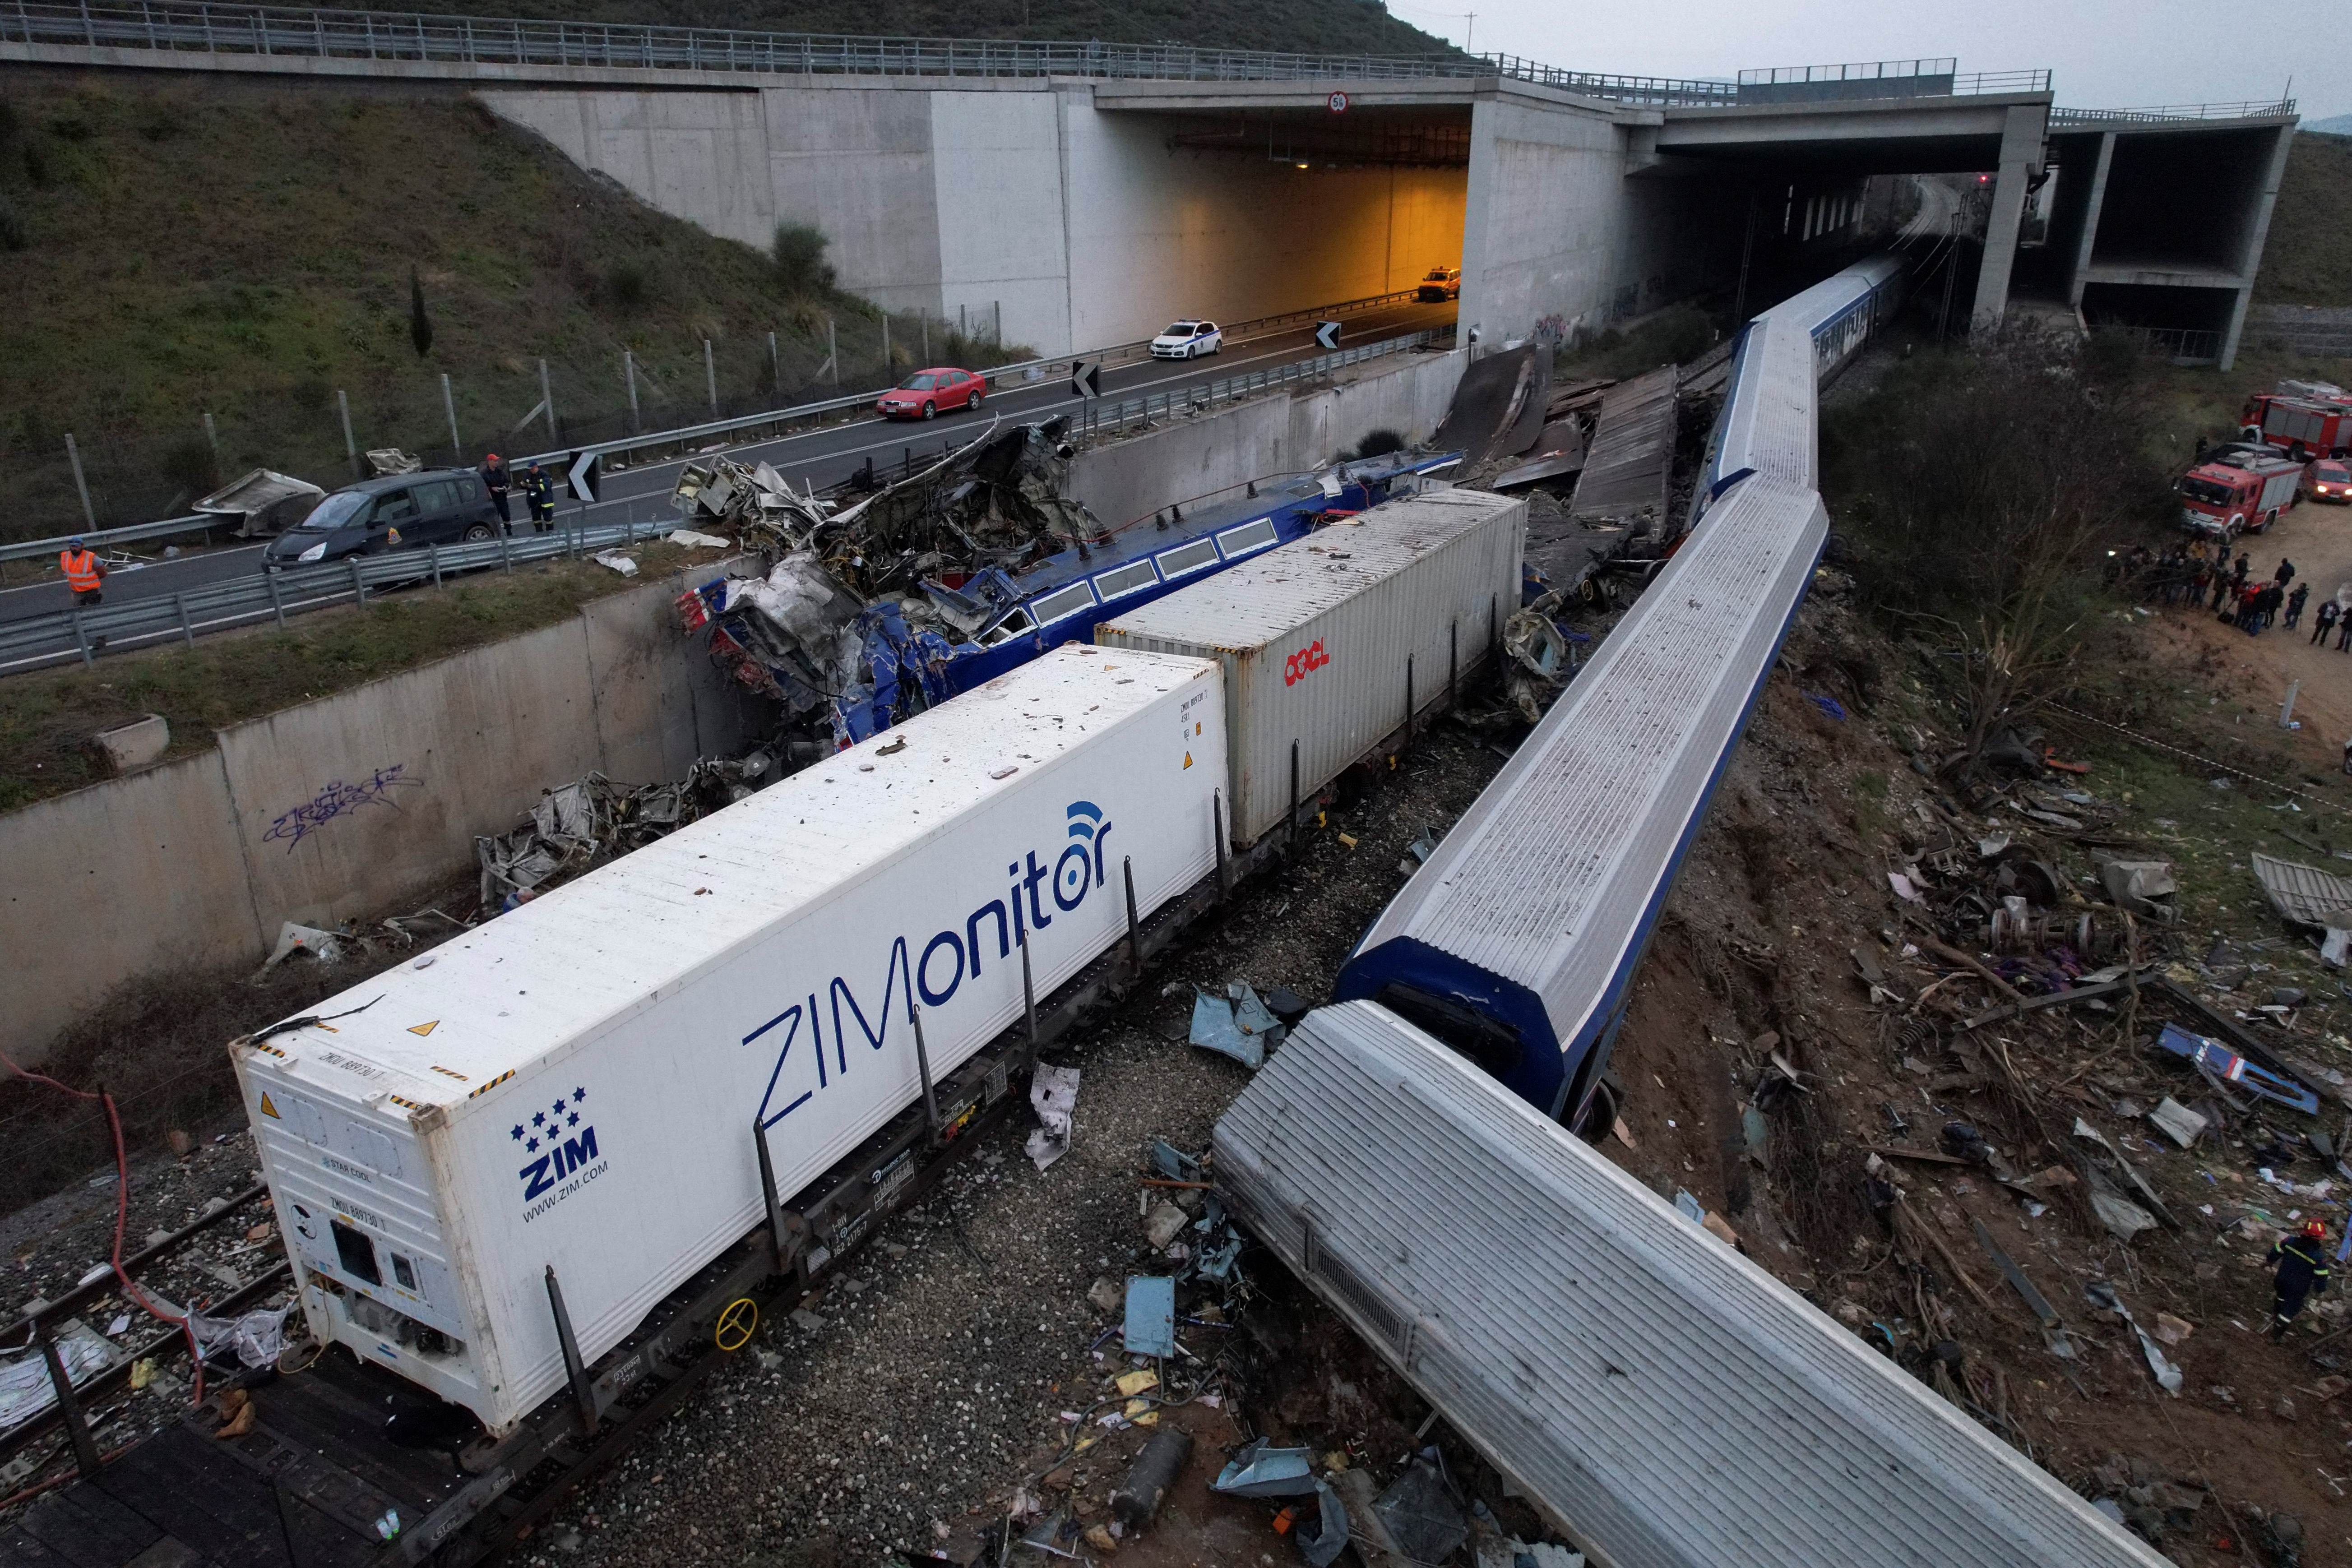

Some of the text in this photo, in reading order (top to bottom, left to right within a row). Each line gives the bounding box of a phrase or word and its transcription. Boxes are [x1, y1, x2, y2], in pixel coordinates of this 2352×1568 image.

[1284, 636, 1329, 687] OOCL
[742, 821, 1112, 1130] ZIMonitor
[319, 1052, 345, 1064] ZMOU
[341, 1060, 375, 1076] 889730
[330, 1160, 371, 1183] STAR COOL
[519, 1125, 599, 1203] ZIM
[330, 1196, 387, 1232] ZMOU 889730 1
[523, 1160, 608, 1223] WWW.ZIM.COM
